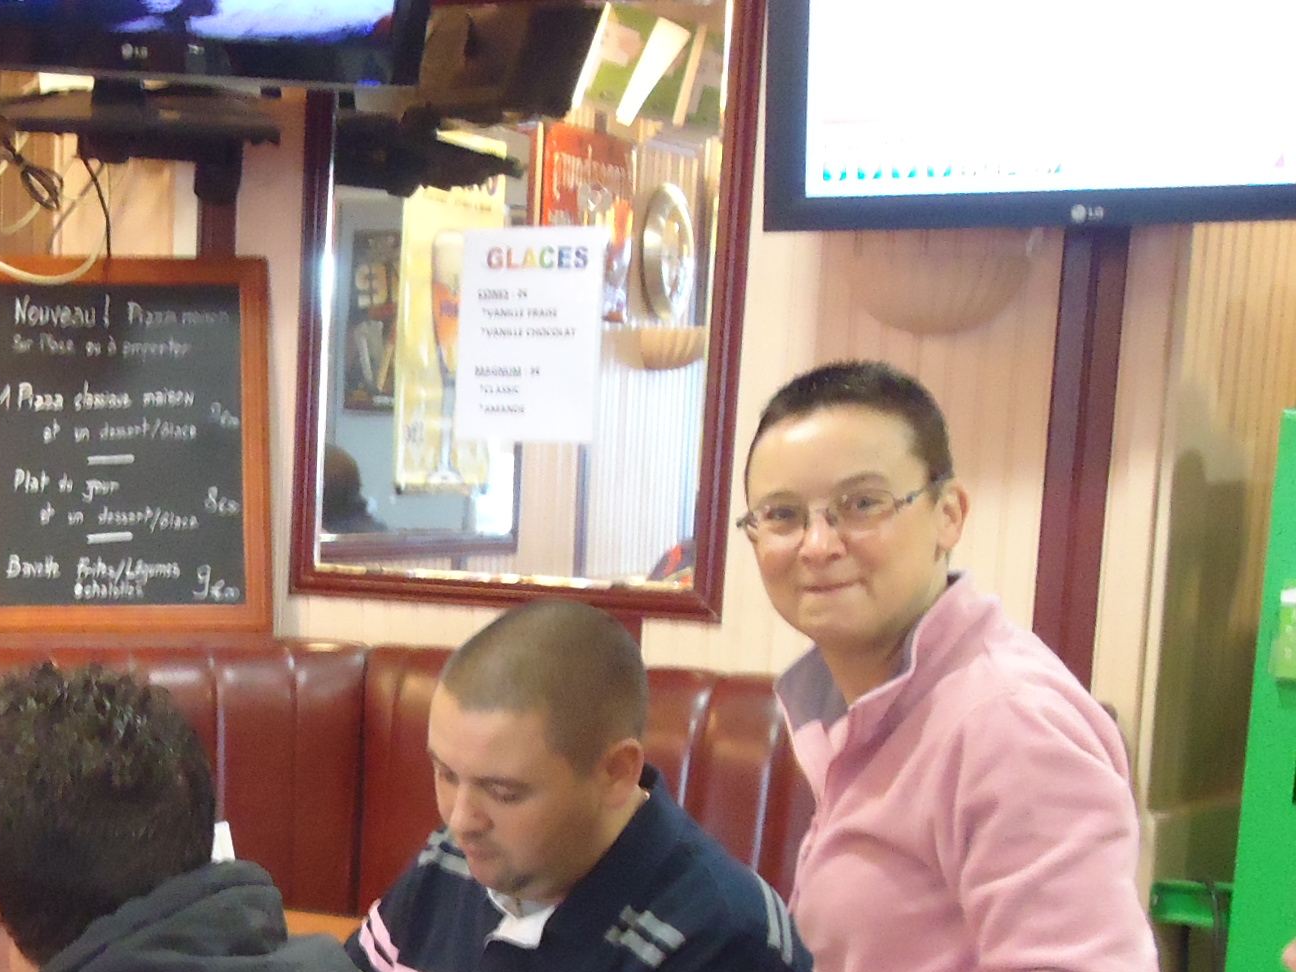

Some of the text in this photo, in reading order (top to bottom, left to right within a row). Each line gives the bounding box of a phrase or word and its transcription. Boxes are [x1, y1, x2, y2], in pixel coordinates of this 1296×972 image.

[1088, 206, 1104, 220] LG
[486, 245, 589, 270] GLACES
[14, 294, 95, 328] Nouveau
[0, 384, 10, 411] 1
[14, 468, 120, 503] Plat du jour
